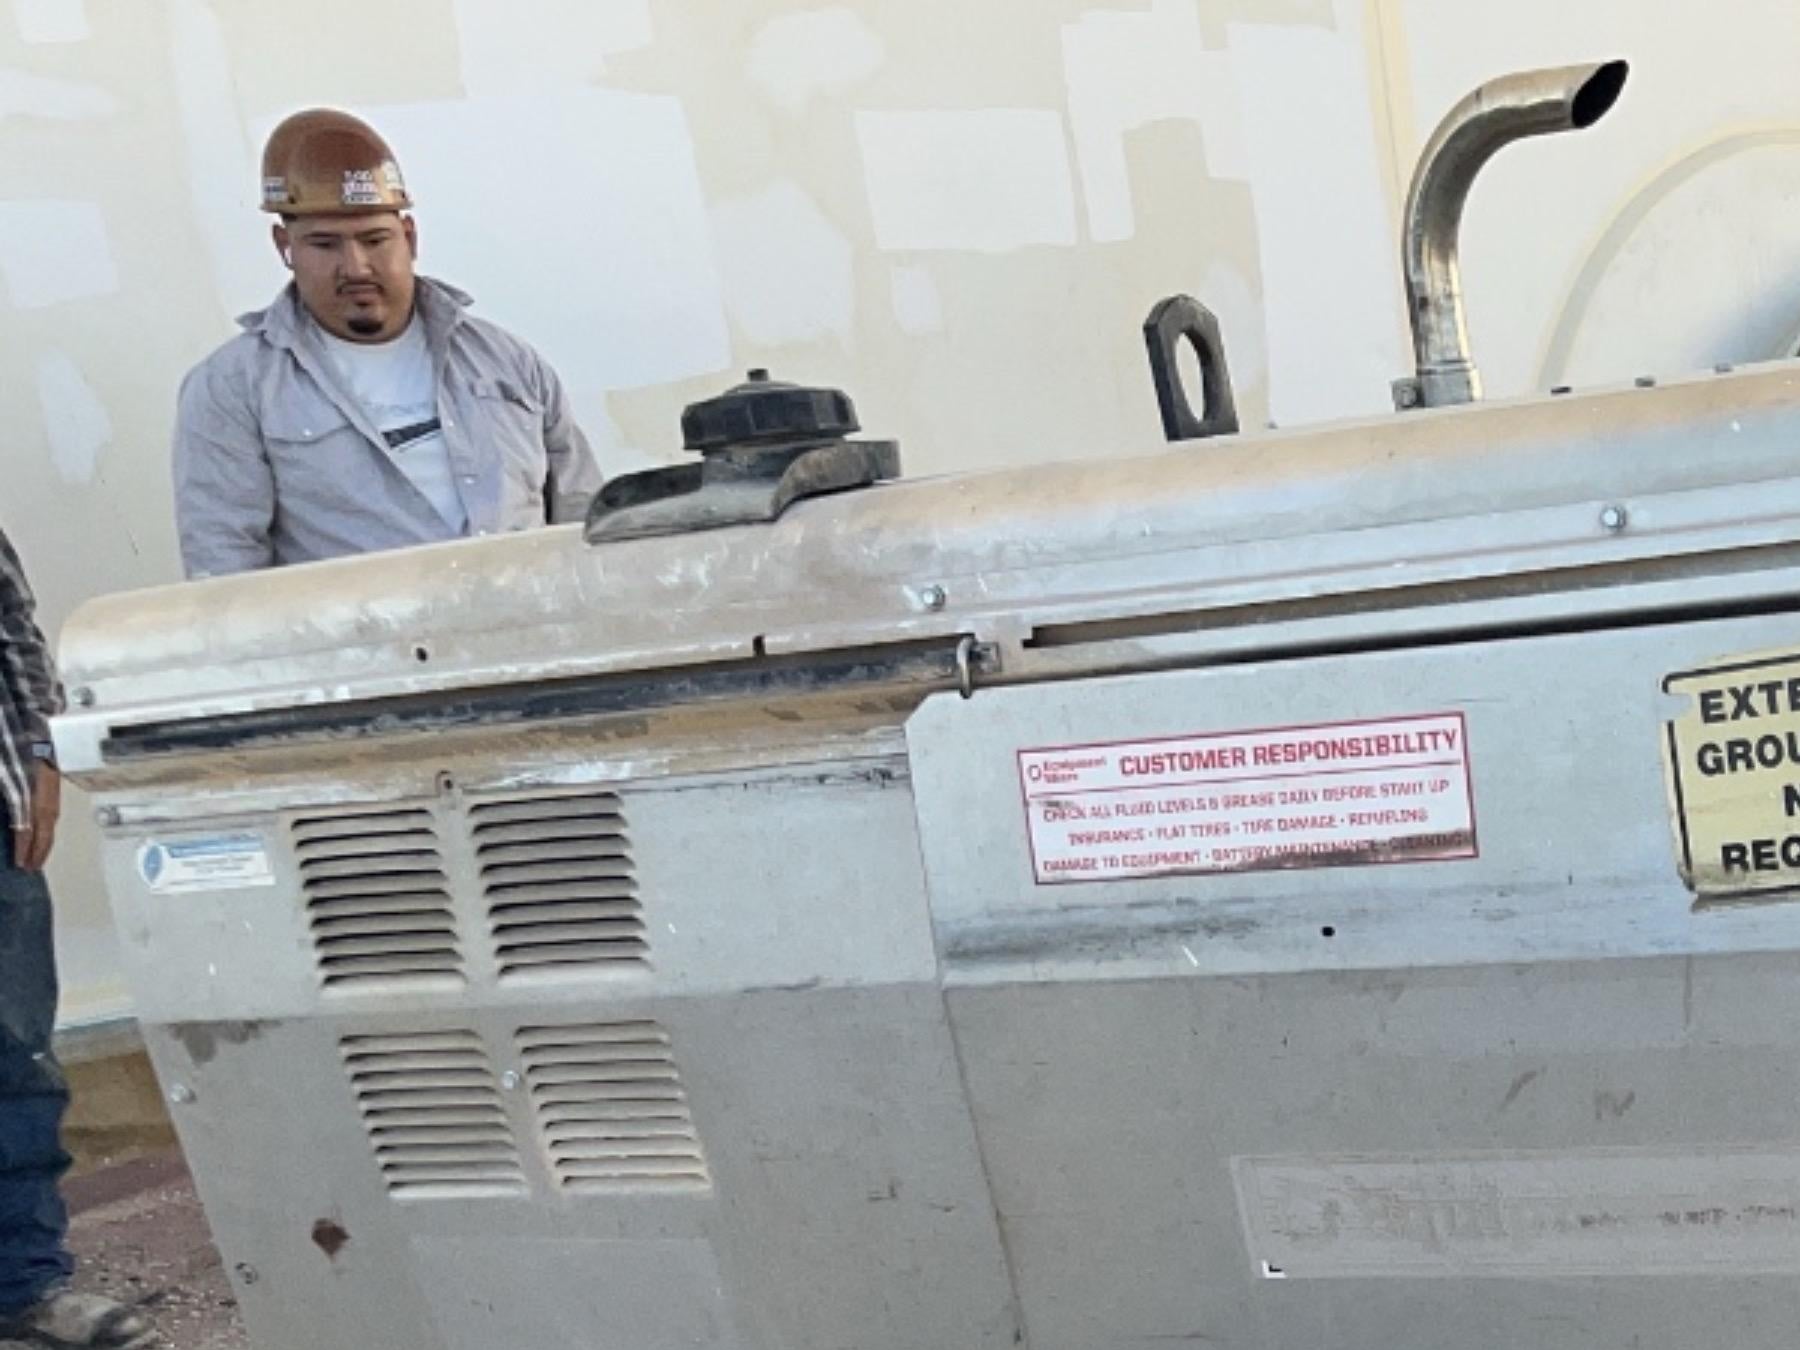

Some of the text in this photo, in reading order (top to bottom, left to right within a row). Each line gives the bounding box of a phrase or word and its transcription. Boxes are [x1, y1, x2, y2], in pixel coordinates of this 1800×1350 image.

[1118, 727, 1458, 776] CUSTOMER RESPONSIBILITY
[1156, 796, 1206, 814] LEVELS
[1275, 814, 1337, 832] DAMAGE
